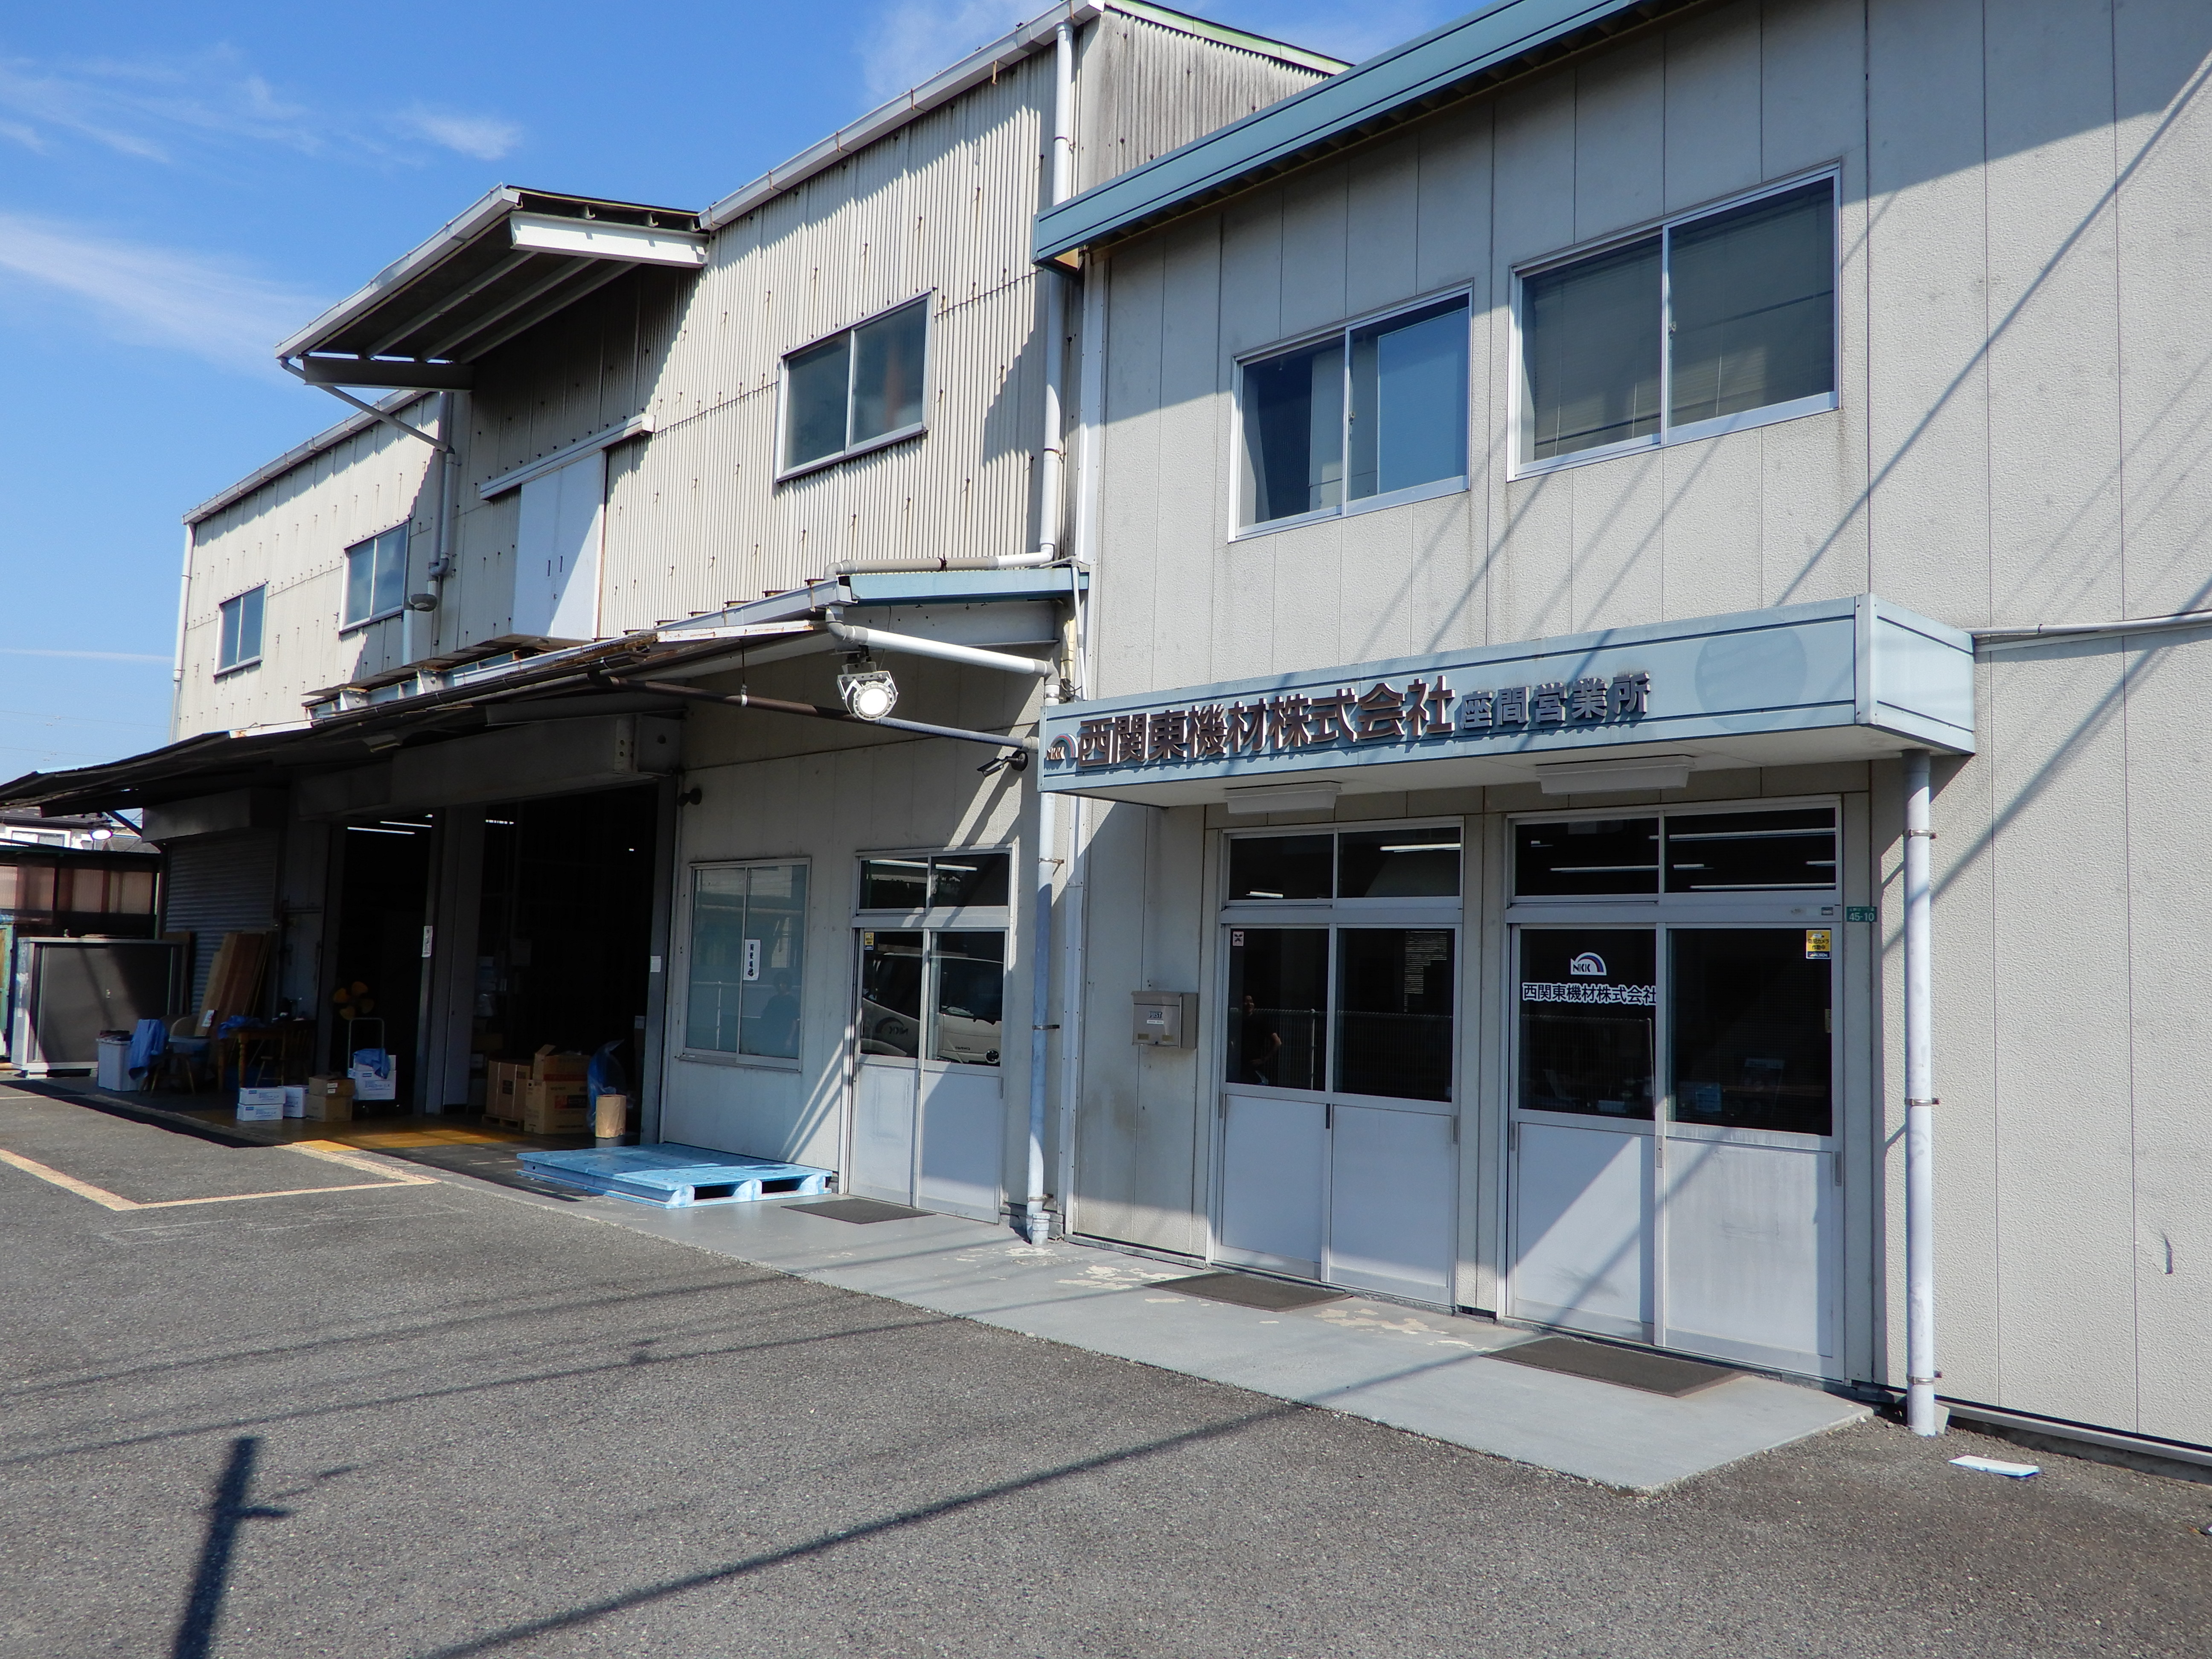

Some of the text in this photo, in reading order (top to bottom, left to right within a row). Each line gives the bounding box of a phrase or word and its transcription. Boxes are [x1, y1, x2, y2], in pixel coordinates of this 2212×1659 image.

[1078, 672, 1650, 766] 西関東機材株式会社 座間営業所
[1047, 747, 1065, 760] NKK
[1849, 912, 1874, 921] 45-10
[1573, 963, 1591, 972] NKK
[1522, 983, 1656, 1005] 西関東機材株式会社
